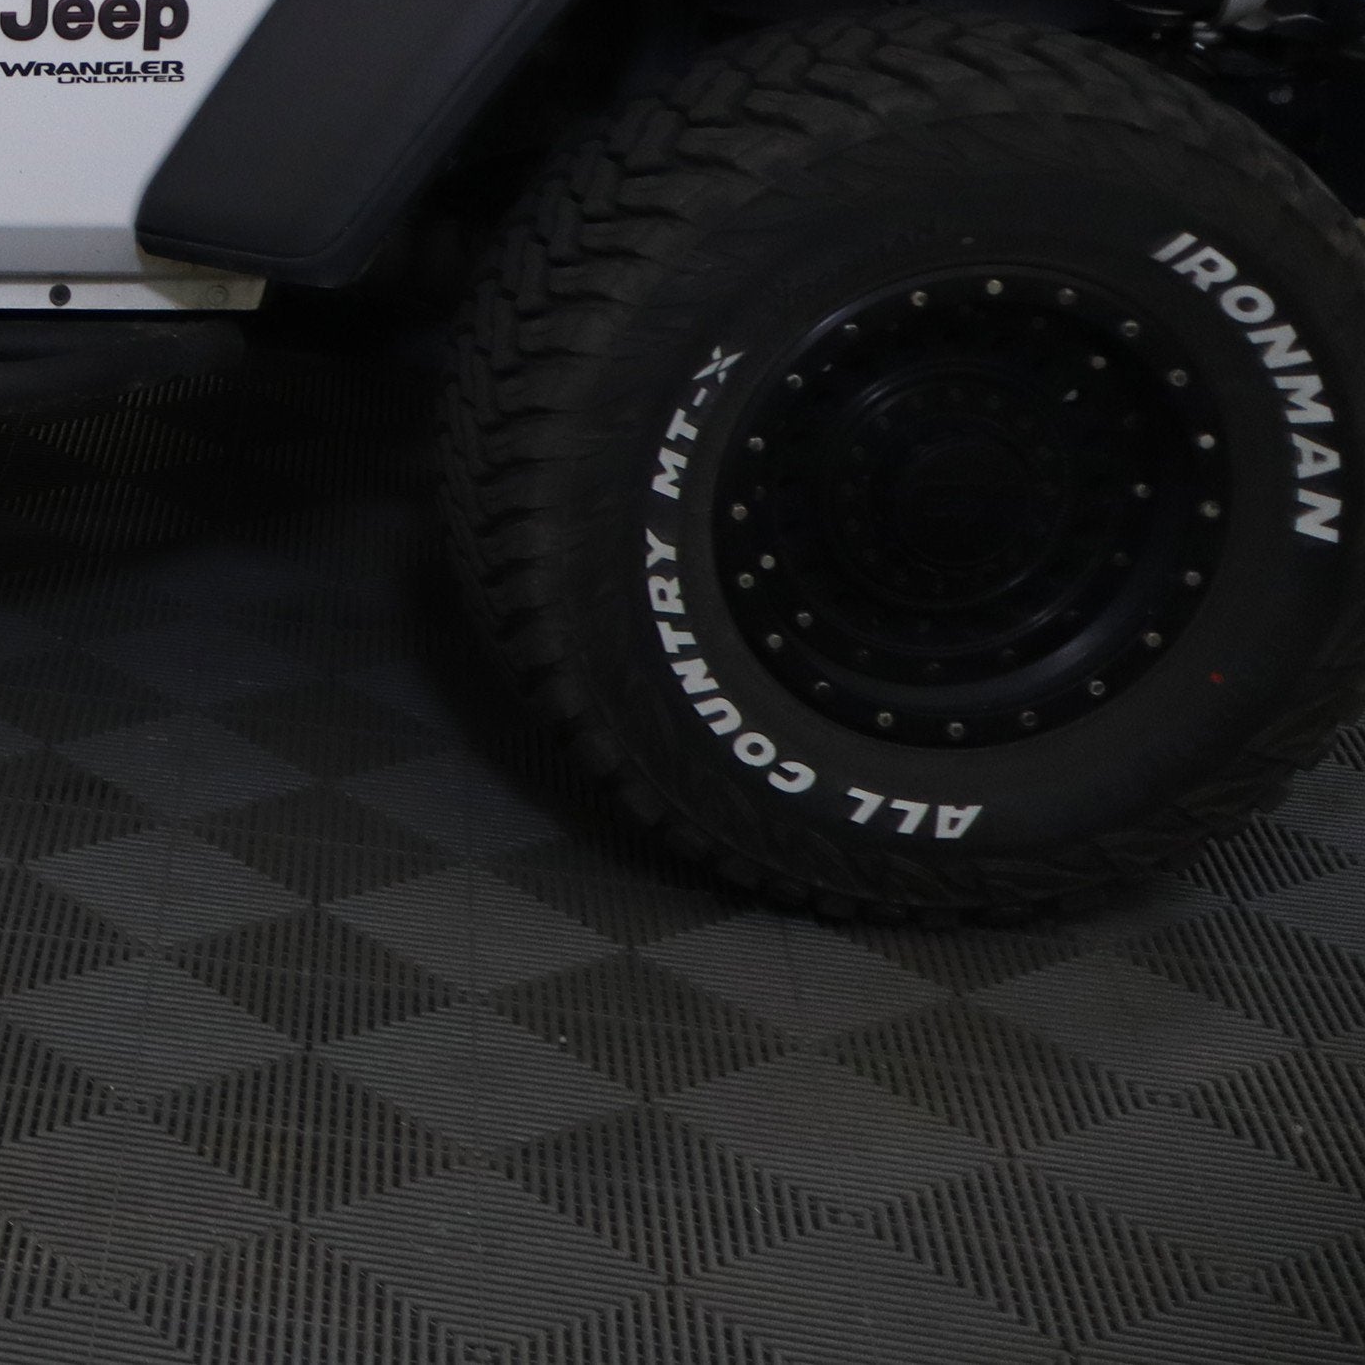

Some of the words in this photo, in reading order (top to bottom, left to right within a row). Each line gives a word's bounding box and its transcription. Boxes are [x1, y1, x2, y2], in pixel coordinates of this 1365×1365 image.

[57, 75, 185, 85] UNLIMITED
[651, 346, 746, 500] MT-X
[1152, 232, 1343, 544] IRONMAN
[645, 528, 818, 794] COUNTRY
[845, 786, 983, 839] ALL
